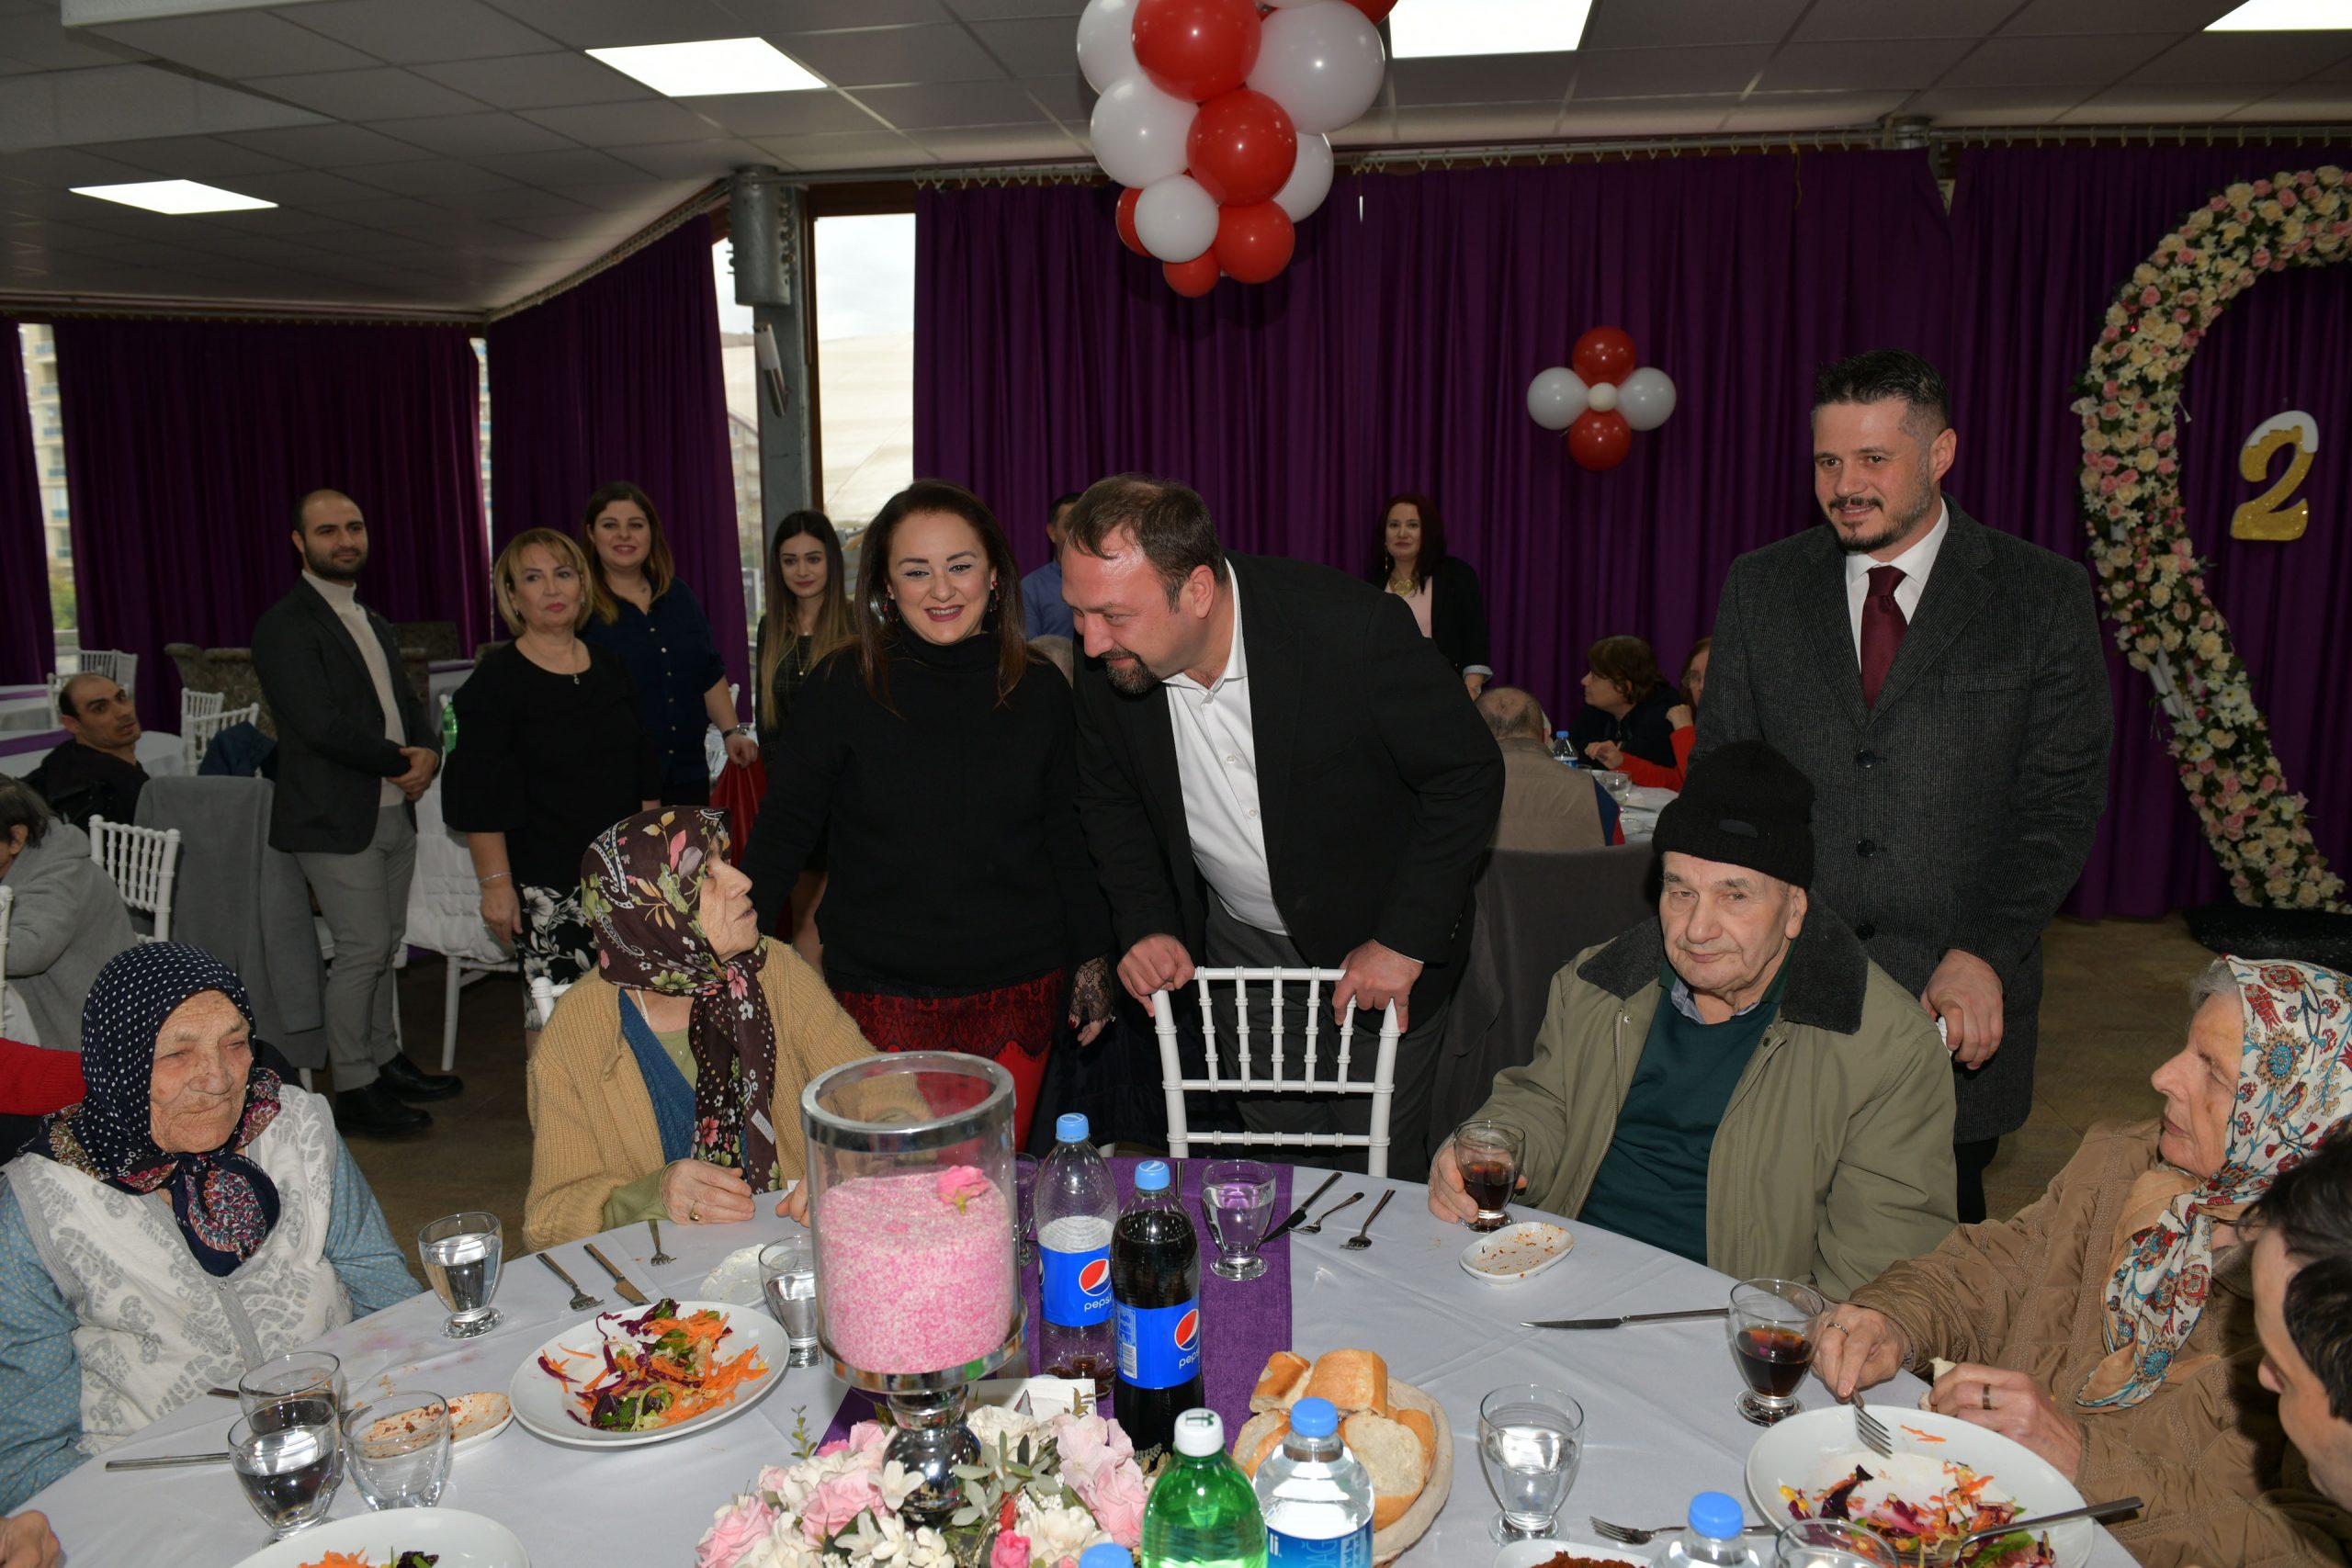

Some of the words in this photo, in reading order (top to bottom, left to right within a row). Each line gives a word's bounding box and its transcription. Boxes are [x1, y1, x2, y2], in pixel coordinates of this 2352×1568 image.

[2230, 410, 2319, 541] 2
[1084, 1292, 1112, 1313] pepsi
[1179, 1349, 1200, 1370] peps
